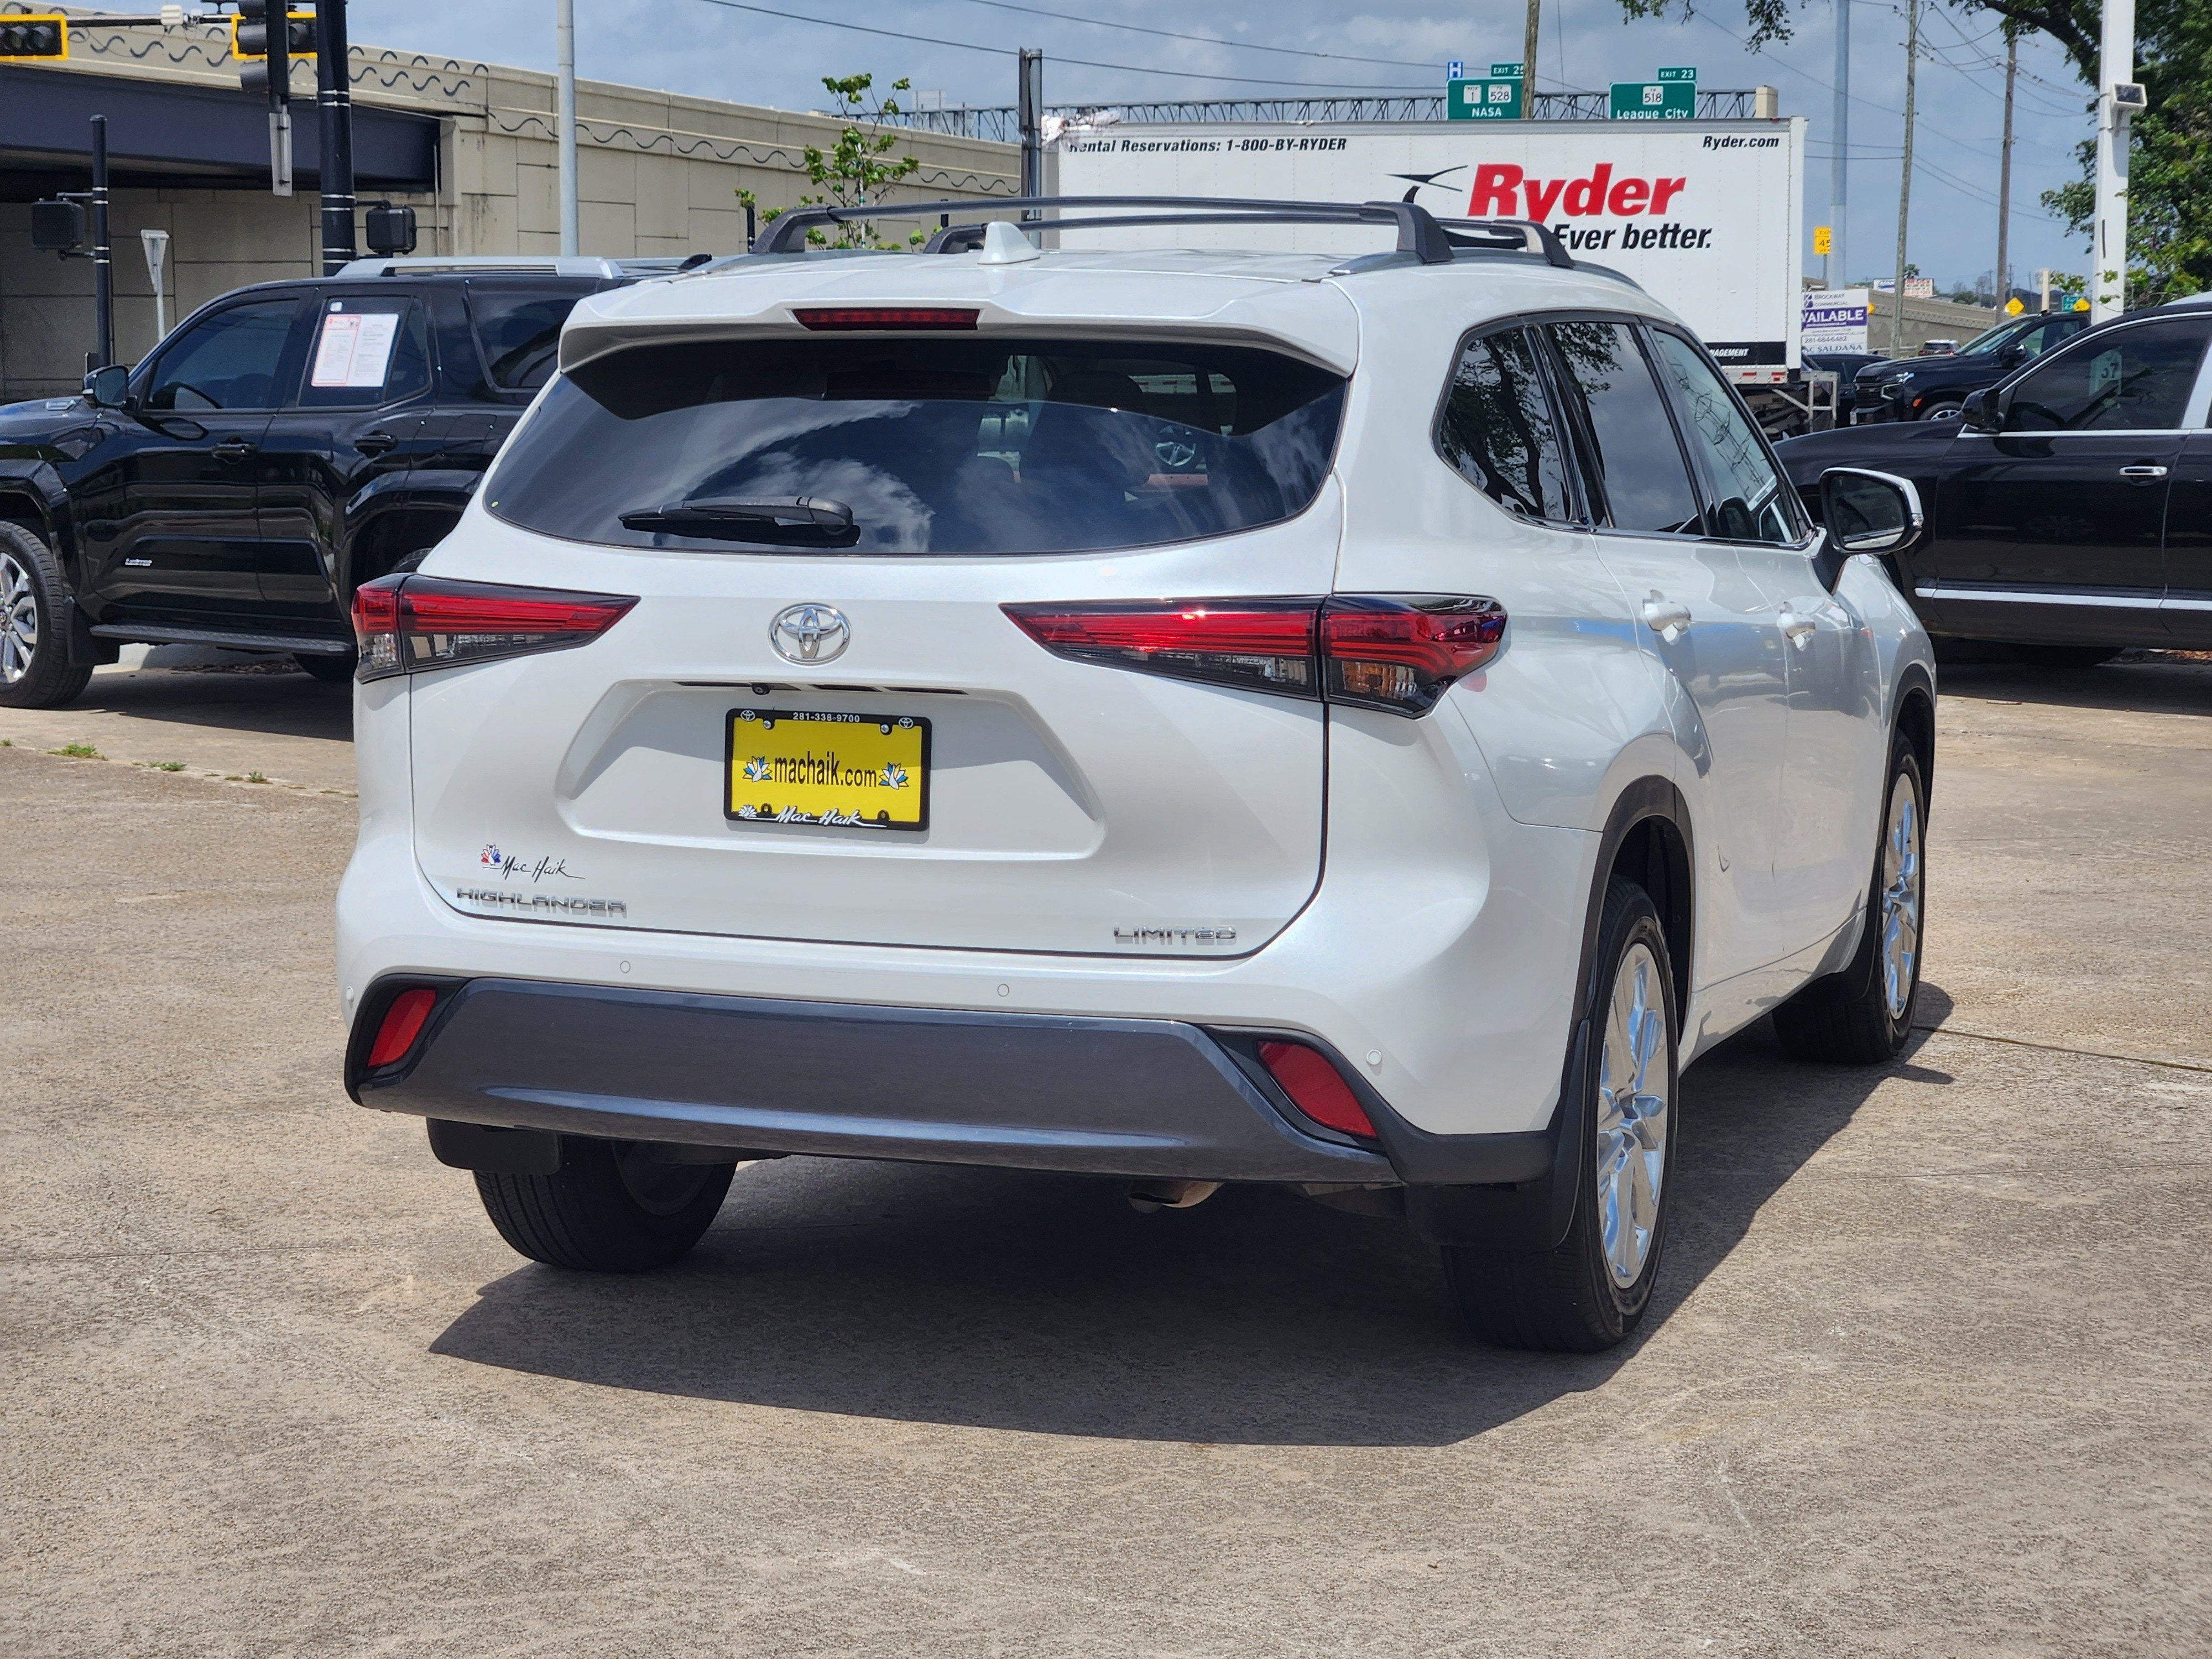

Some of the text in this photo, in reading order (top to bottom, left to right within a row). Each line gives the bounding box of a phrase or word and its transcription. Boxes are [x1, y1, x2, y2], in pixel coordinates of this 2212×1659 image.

[1449, 62, 1462, 78] H
[1681, 69, 1694, 79] 23
[1490, 91, 1510, 101] 528
[1644, 93, 1662, 103] 518
[1471, 106, 1503, 118] NASA
[1616, 107, 1689, 119] League City
[1120, 139, 1221, 152] Reservations:
[1227, 138, 1348, 152] 1-800-BY-RYDER
[1702, 135, 1780, 151] Ryder.com
[1467, 163, 1687, 223] Ryder
[1552, 222, 1713, 250] Ever better.
[1801, 309, 1864, 323] VAILABLE
[1709, 348, 1750, 357] NAGEMENT
[792, 712, 860, 723] 281-338-9700
[774, 750, 877, 788] machaik.com
[774, 805, 863, 826] Mac Haik
[500, 855, 572, 883] Mac Haik
[457, 887, 627, 913] HIGHLANDER
[1113, 922, 1238, 940] LIMITED
